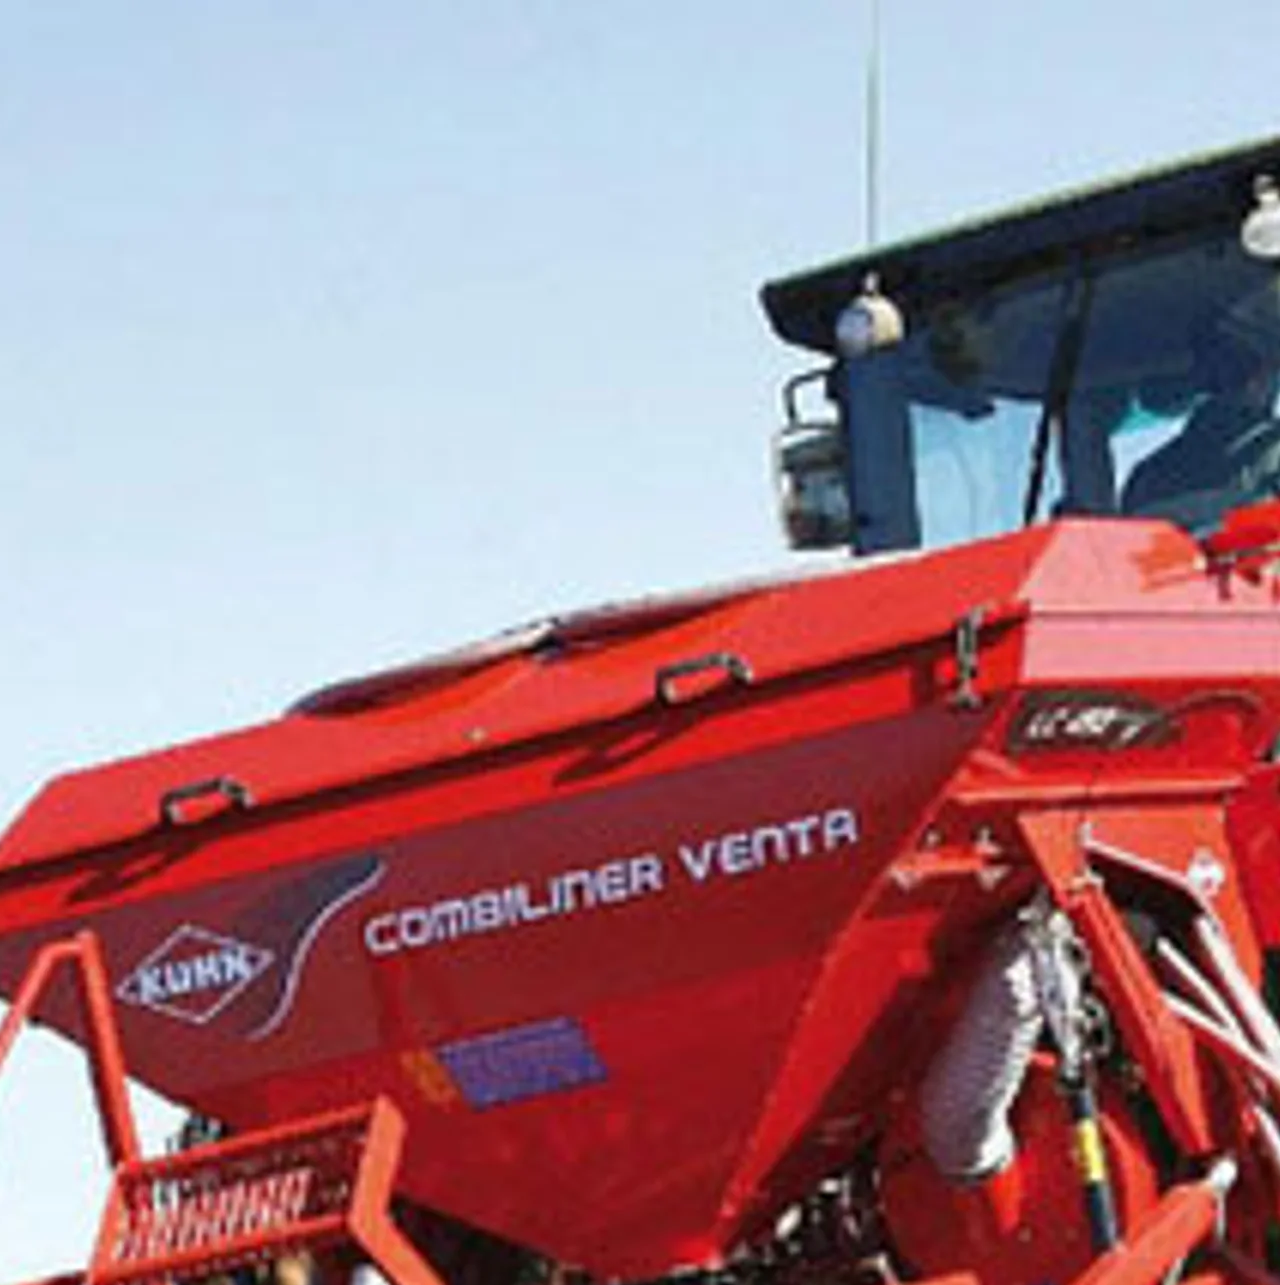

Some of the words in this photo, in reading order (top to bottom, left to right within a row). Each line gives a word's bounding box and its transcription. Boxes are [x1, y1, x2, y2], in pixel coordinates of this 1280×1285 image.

[364, 853, 664, 954] COMBILINER
[679, 808, 859, 882] VENTA
[138, 944, 254, 1003] KUHN
